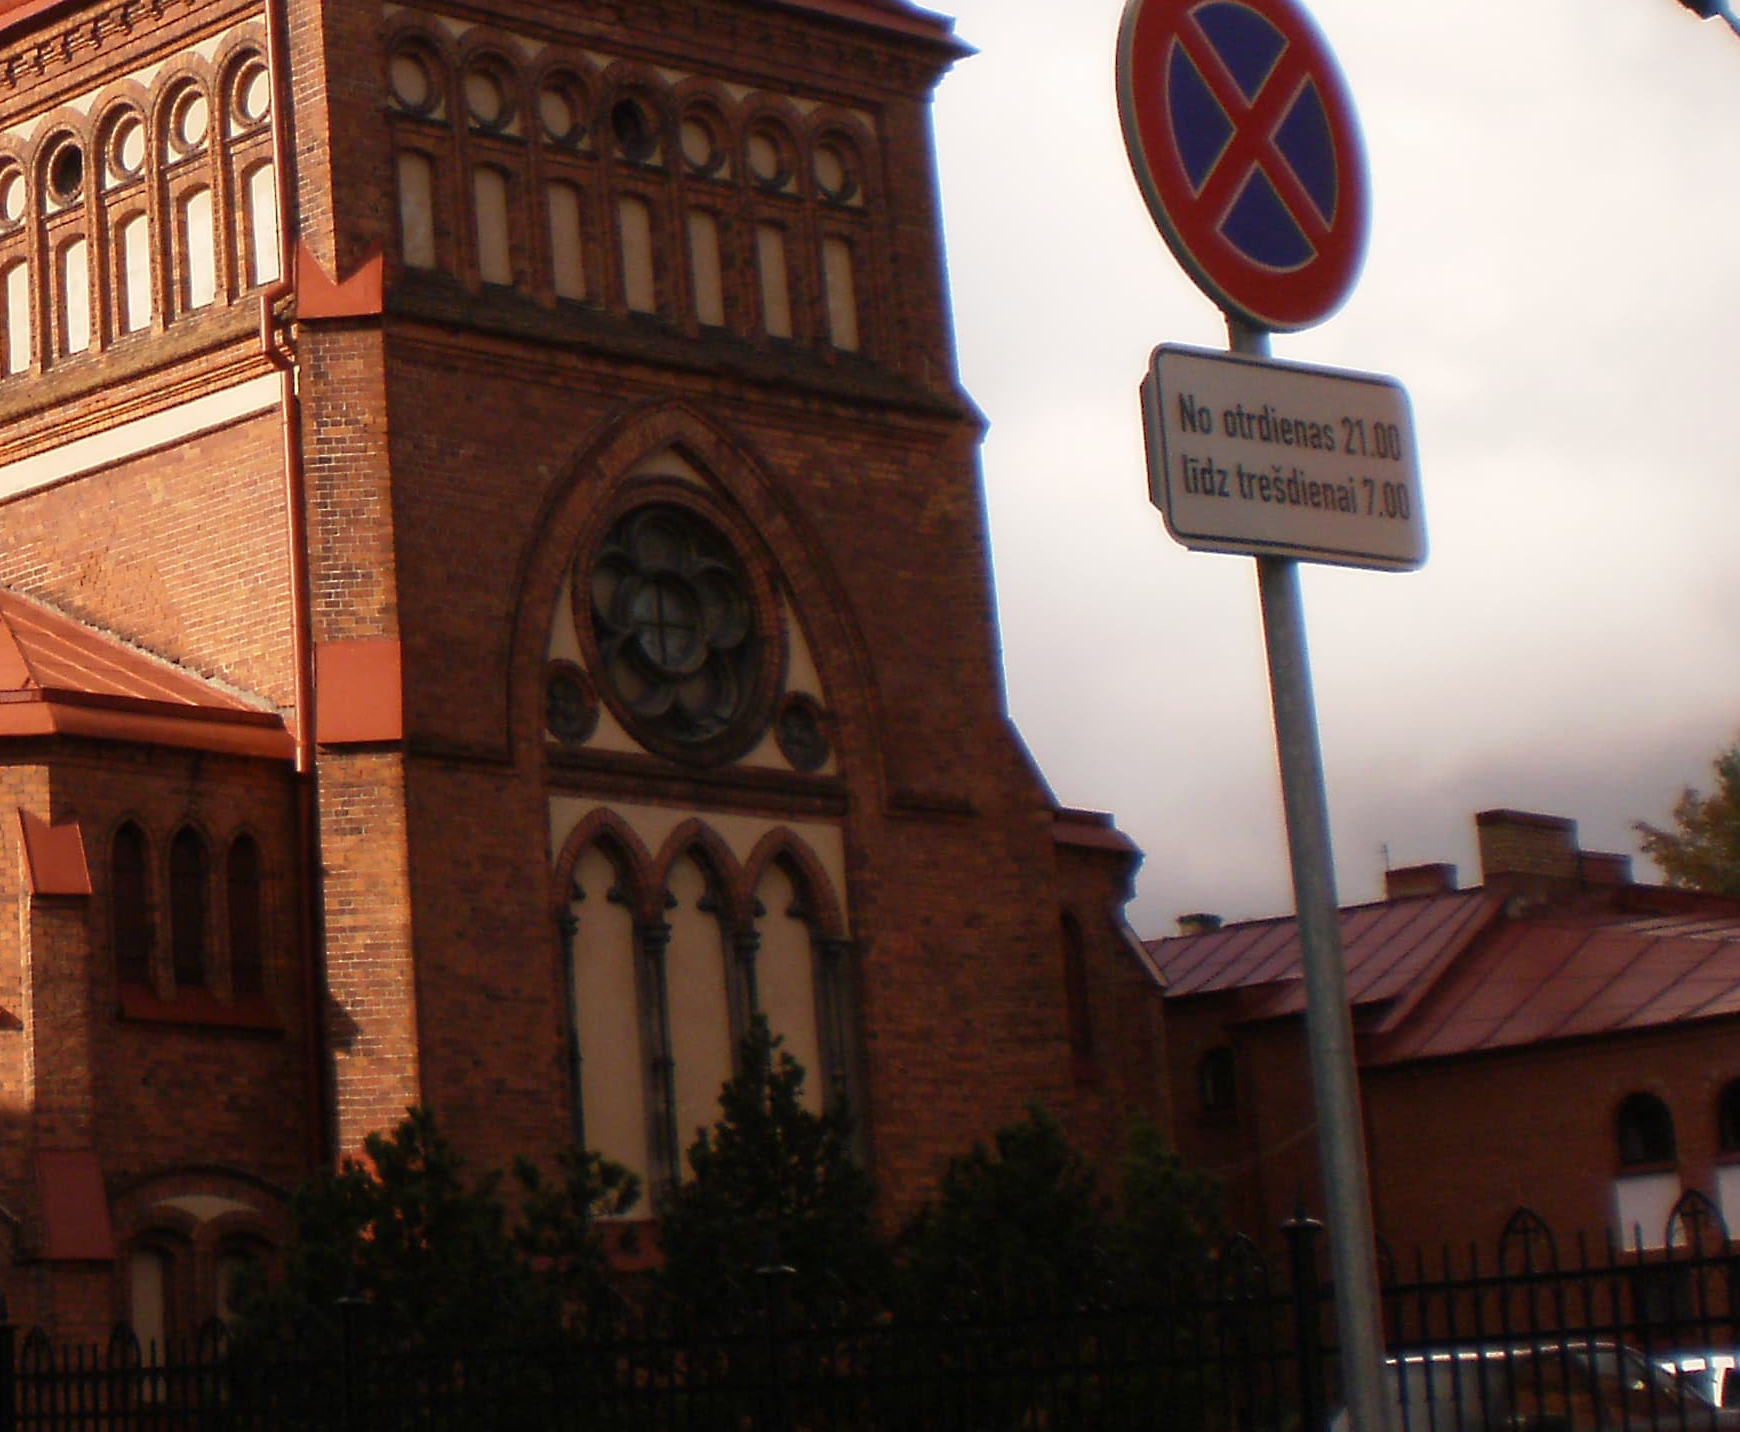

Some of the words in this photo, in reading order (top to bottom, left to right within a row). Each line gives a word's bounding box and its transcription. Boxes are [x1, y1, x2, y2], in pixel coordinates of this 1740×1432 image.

[1178, 392, 1213, 435] No
[1223, 403, 1336, 452] otrdienas
[1341, 417, 1402, 461] 21.00
[1181, 454, 1230, 498] līdz
[1236, 462, 1357, 515] trešdienai
[1363, 477, 1412, 520] 7.00
